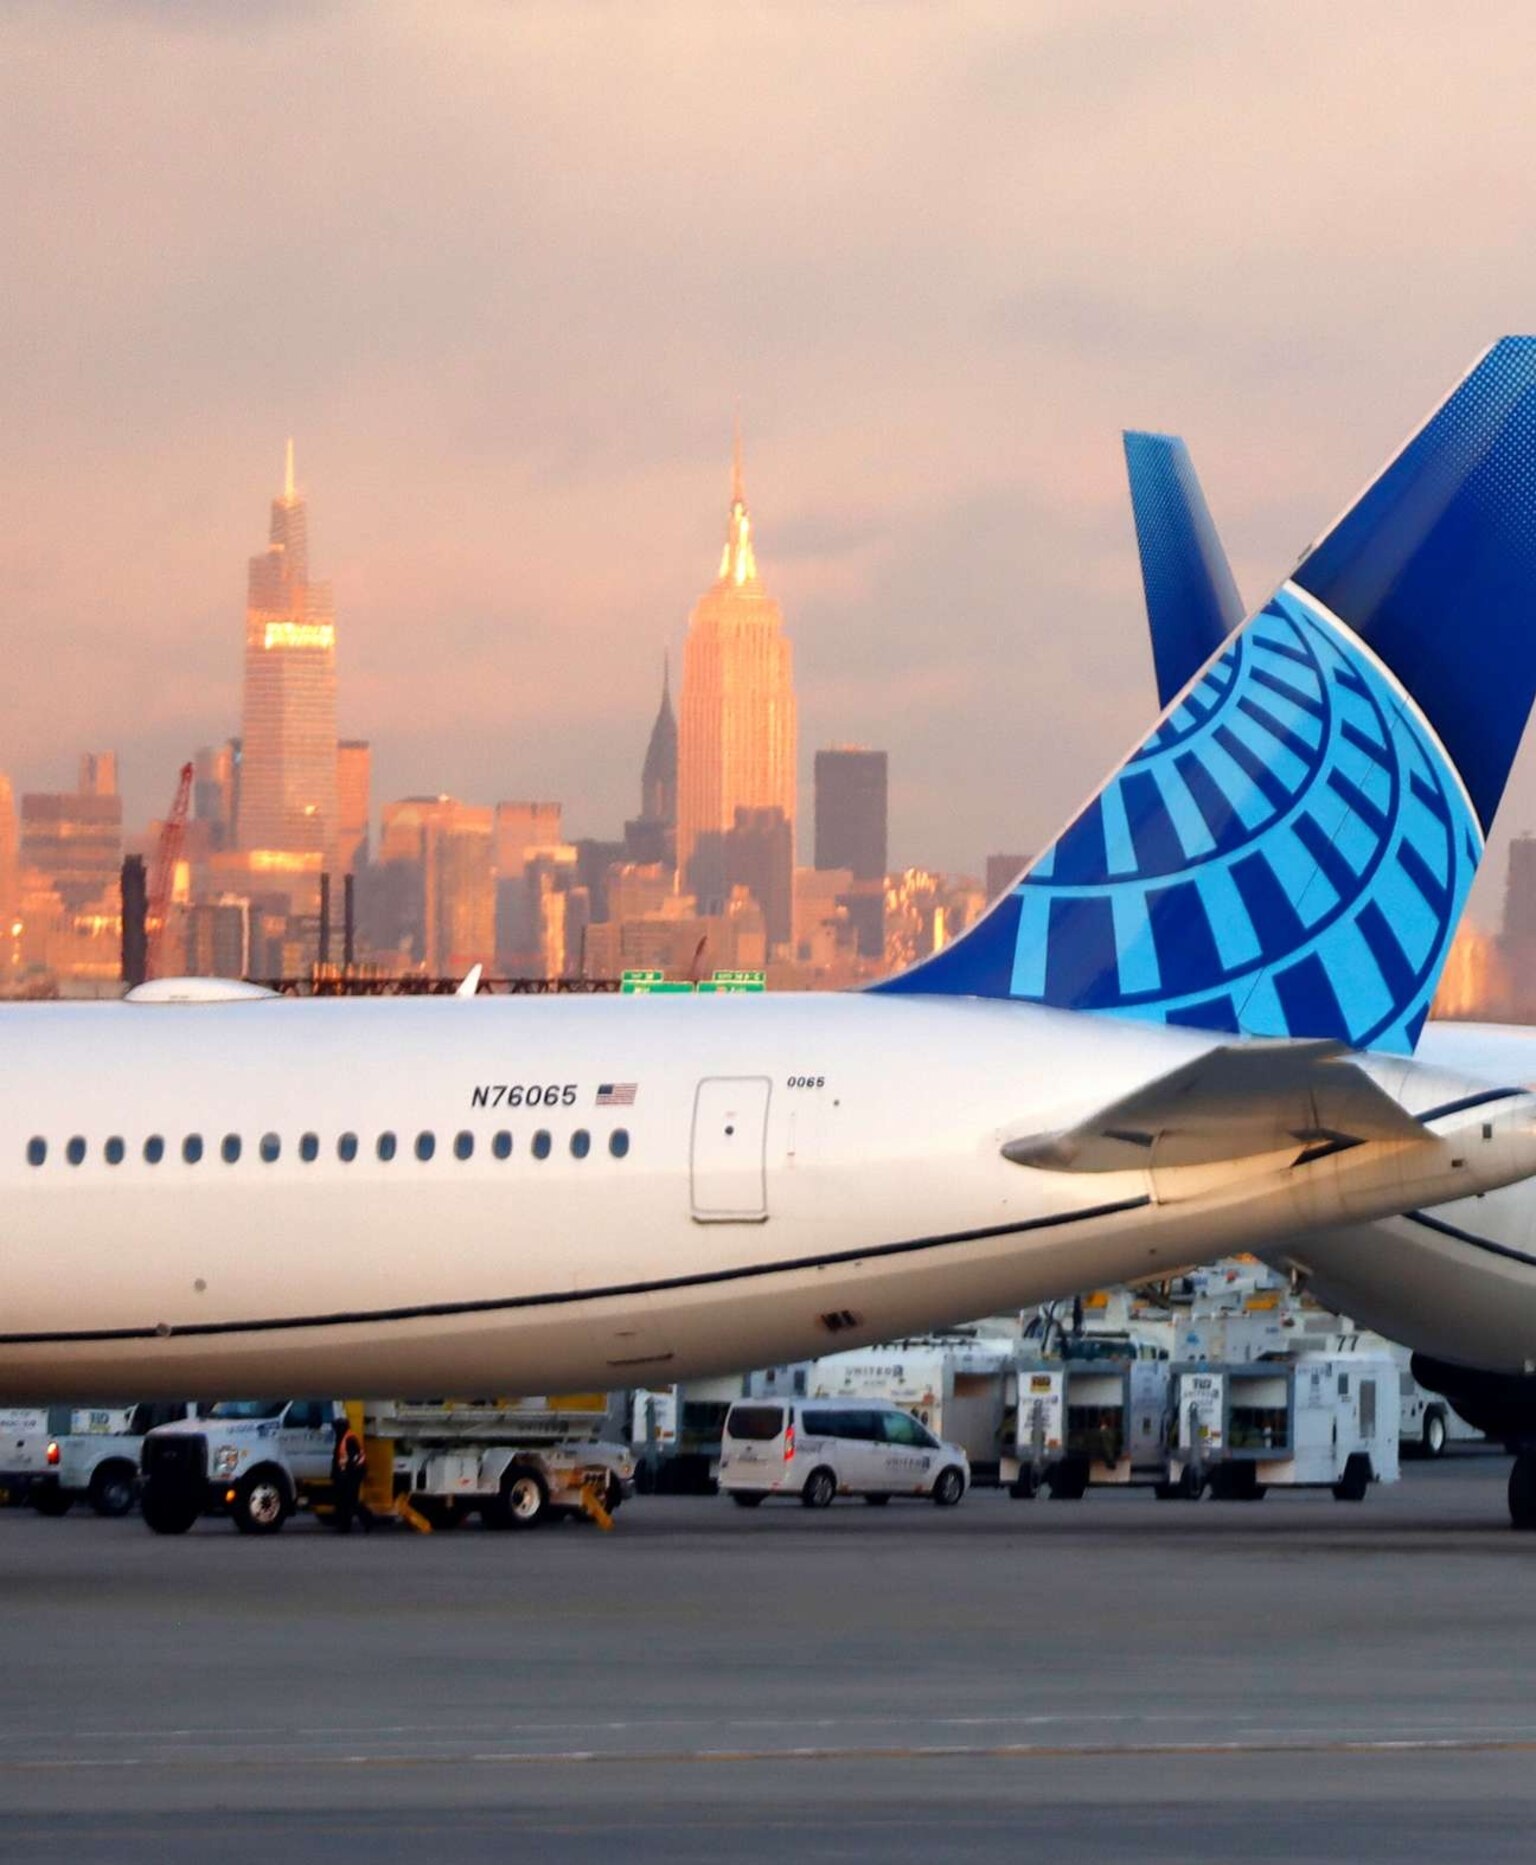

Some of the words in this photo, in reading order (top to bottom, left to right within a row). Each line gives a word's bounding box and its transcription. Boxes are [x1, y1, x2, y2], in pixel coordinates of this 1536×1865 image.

[786, 1075, 825, 1088] 0065
[471, 1084, 577, 1107] N76065
[1336, 1334, 1358, 1352] 77
